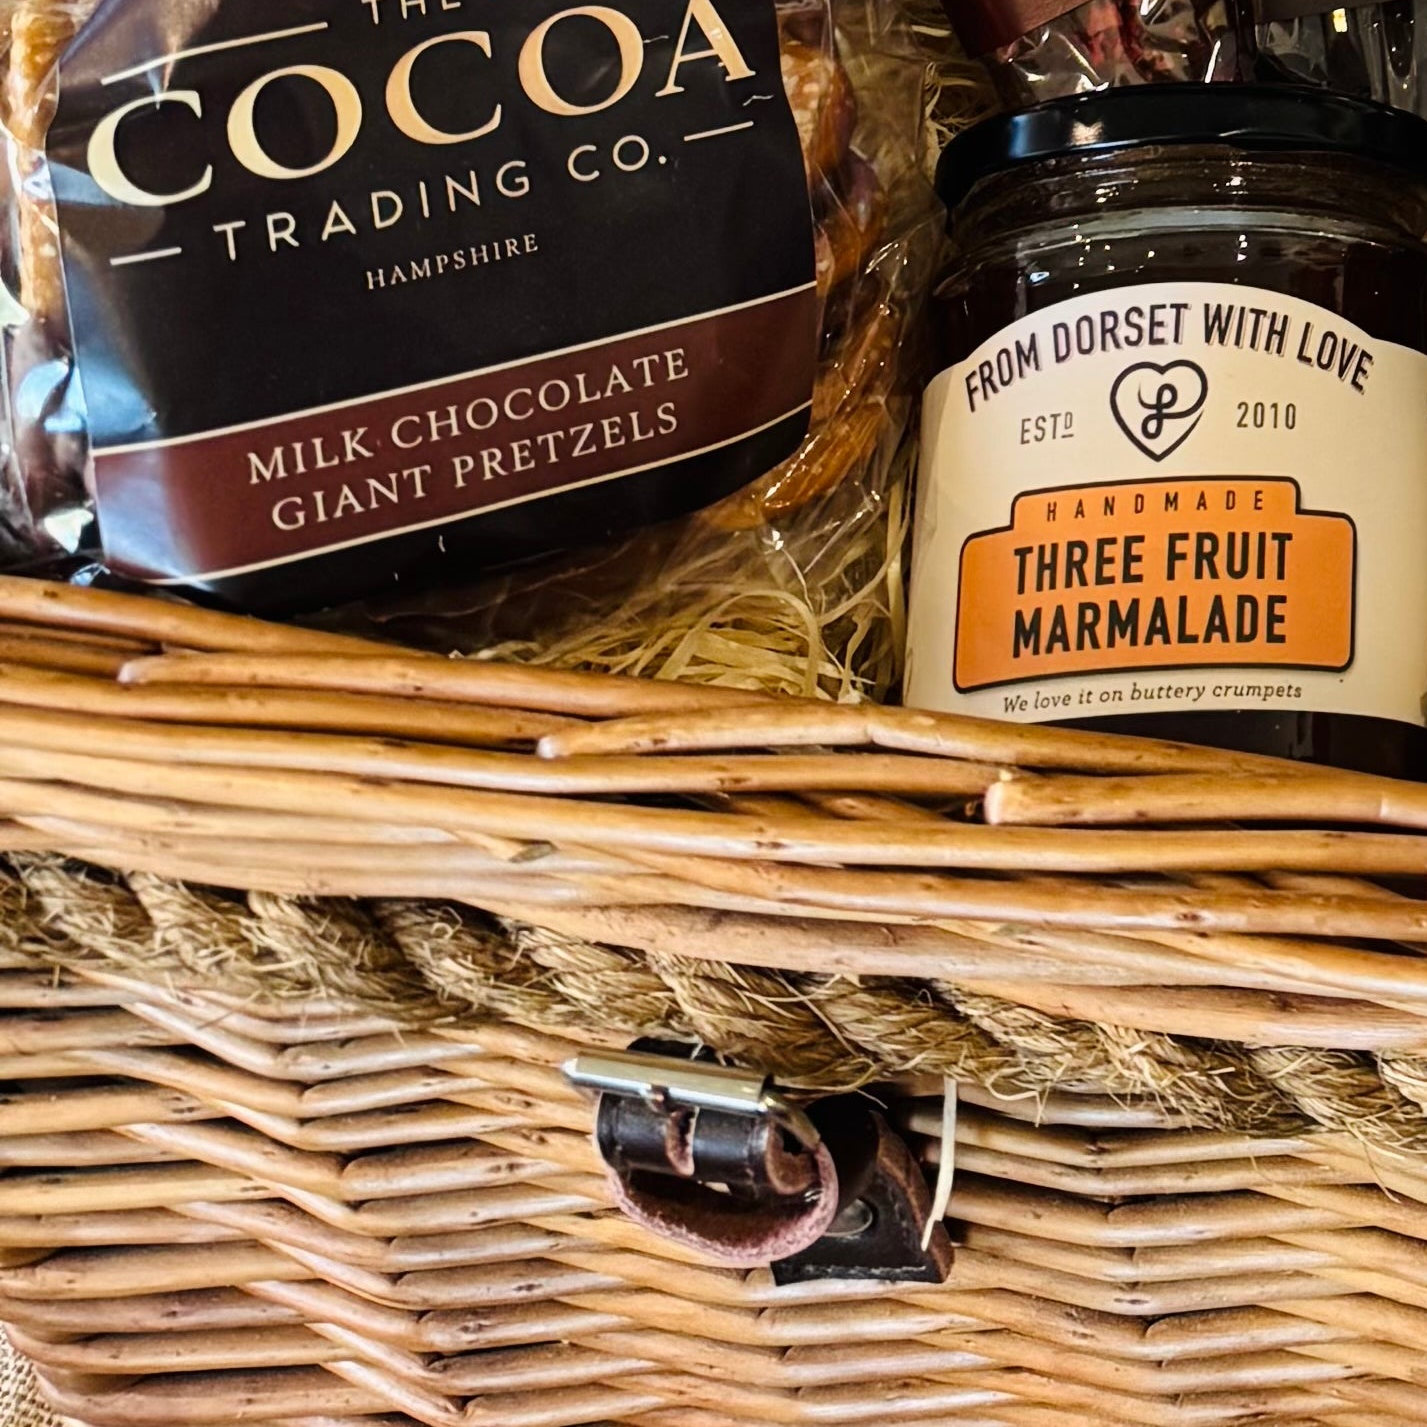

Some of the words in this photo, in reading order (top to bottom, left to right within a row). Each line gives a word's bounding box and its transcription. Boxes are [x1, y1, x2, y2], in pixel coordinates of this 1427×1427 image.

[212, 160, 531, 263] TRADING
[566, 134, 668, 183] CO.
[366, 234, 540, 290] HAMPSHIRE
[965, 333, 1041, 412] FROM
[1053, 304, 1190, 364] DORSET
[1204, 304, 1290, 355] WITH
[1297, 321, 1375, 394] LOVE
[248, 429, 373, 486] MILK
[391, 348, 691, 449] CHOCOLATE
[271, 466, 432, 532] GIANT
[452, 403, 679, 490] PRETZELS
[1015, 536, 1146, 595] THREE
[1166, 532, 1294, 581] FRUIT
[1013, 595, 1287, 659] MARMALADE
